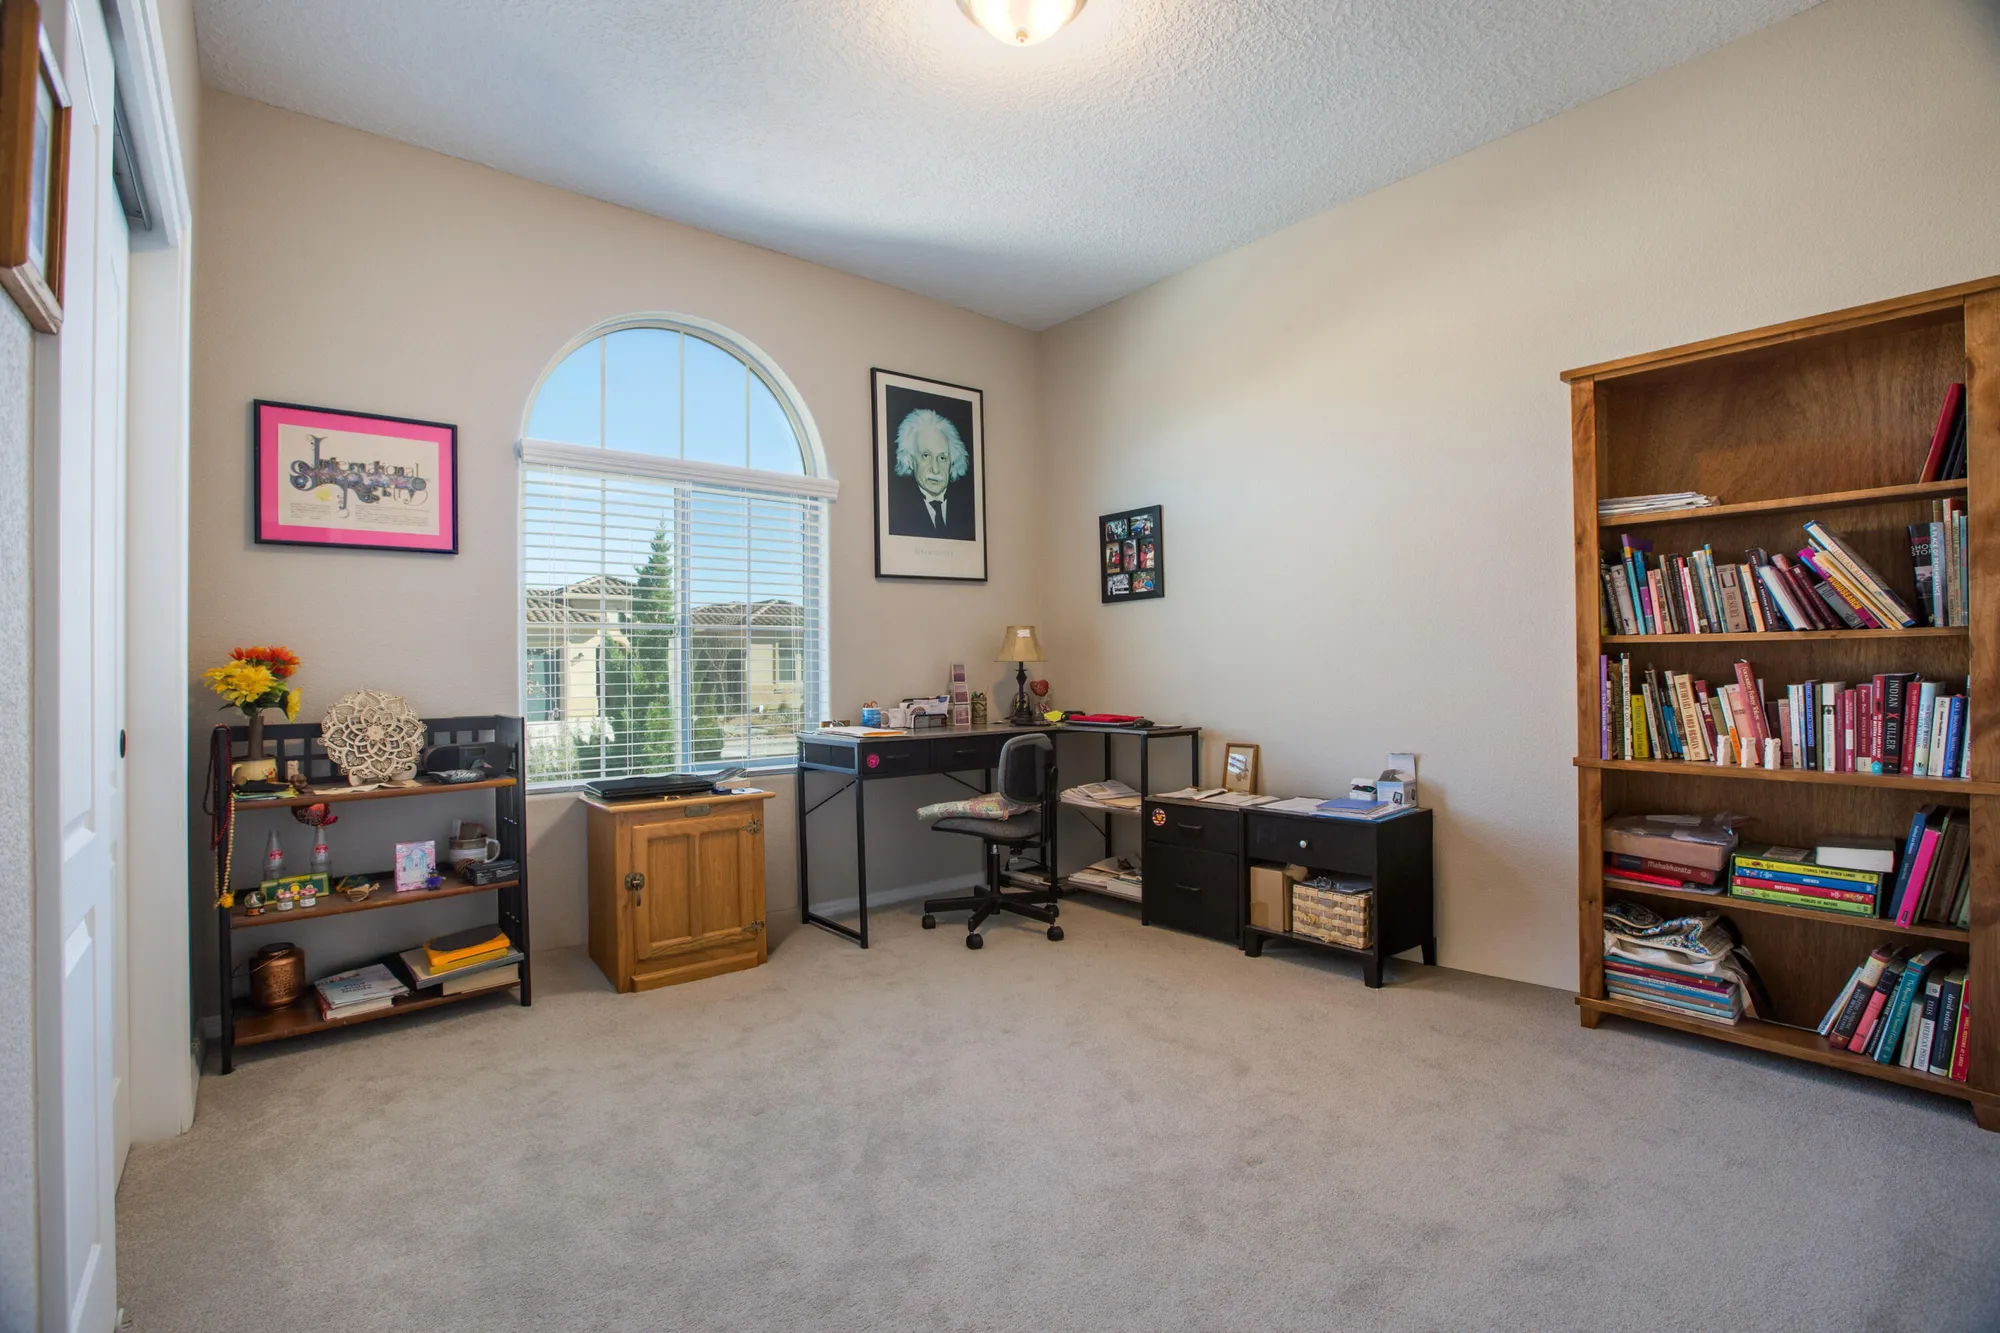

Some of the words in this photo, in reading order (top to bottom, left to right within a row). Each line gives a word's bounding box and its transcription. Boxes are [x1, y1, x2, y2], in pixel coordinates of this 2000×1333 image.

[1828, 575, 1863, 610] WORDSEARCH
[1888, 679, 1899, 707] INDIAN
[1886, 722, 1897, 750] KILLER
[1647, 860, 1692, 875] Mahabharata
[1945, 993, 1956, 1010] david
[1942, 1010, 1953, 1031] sedaris
